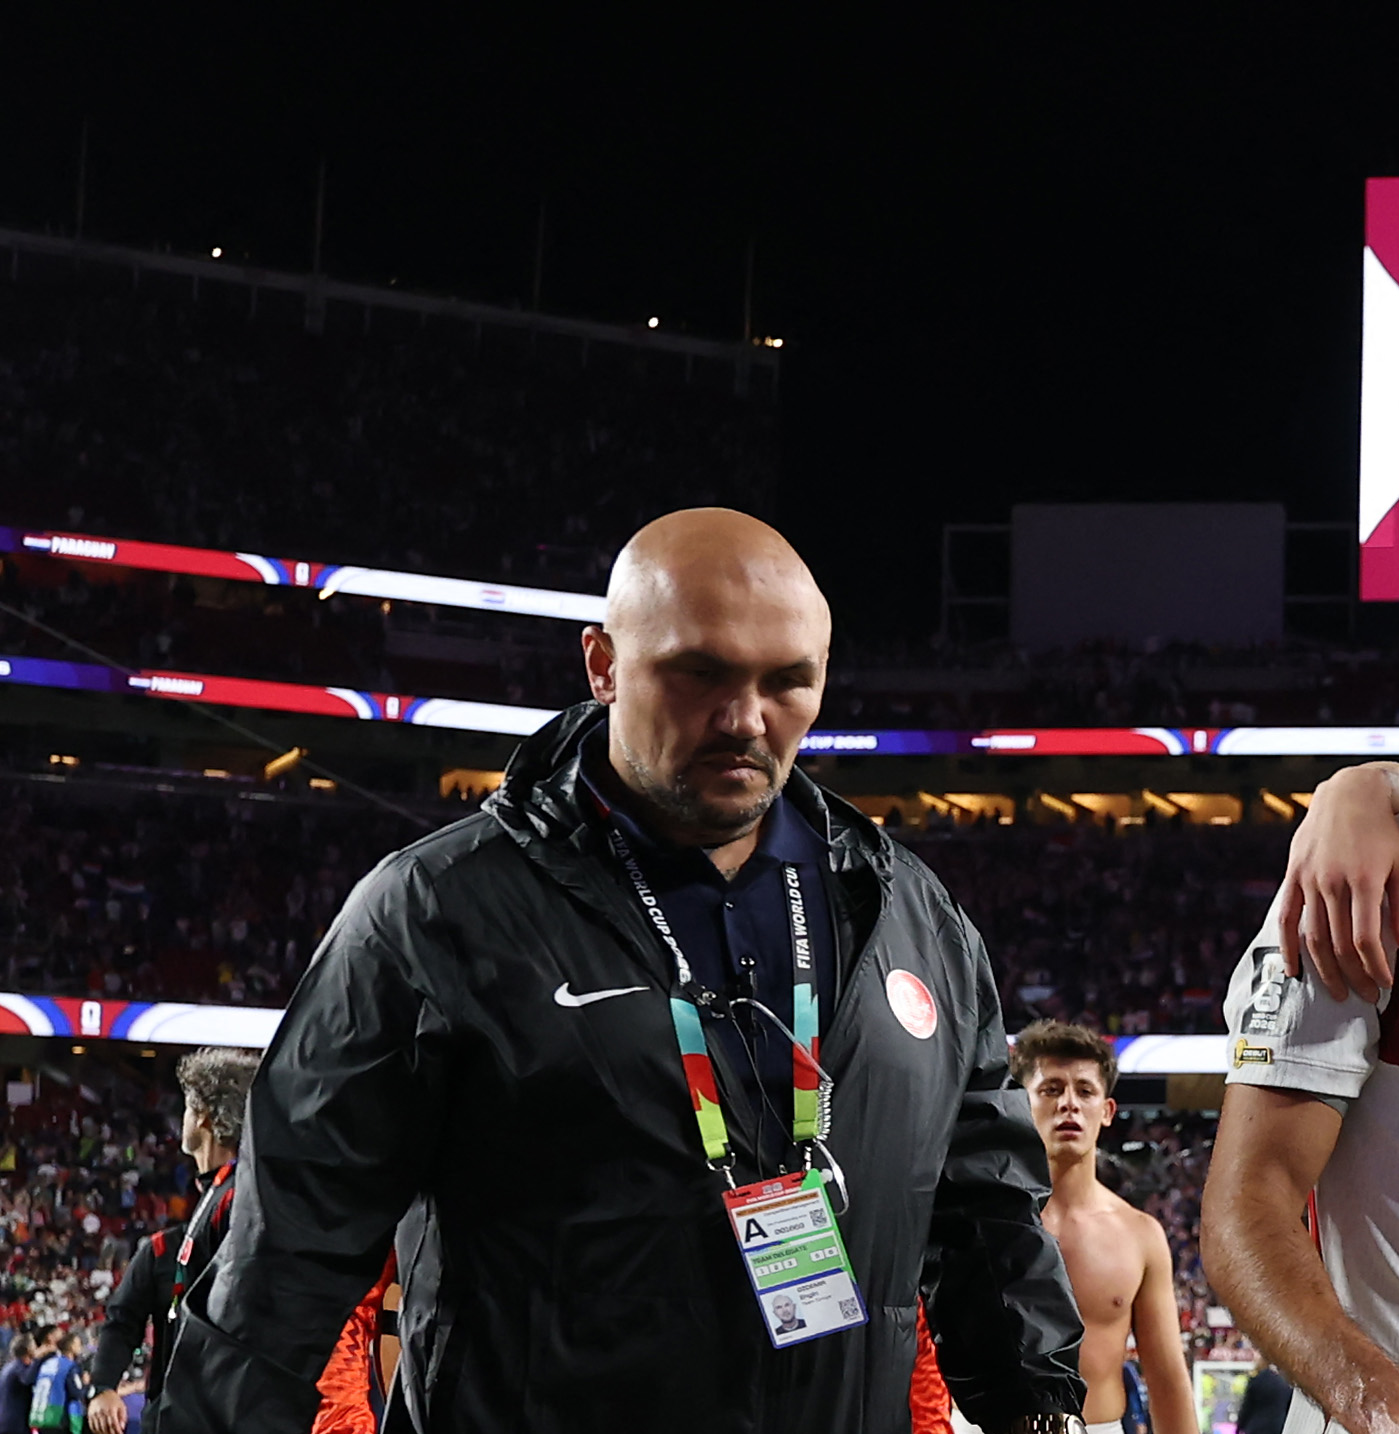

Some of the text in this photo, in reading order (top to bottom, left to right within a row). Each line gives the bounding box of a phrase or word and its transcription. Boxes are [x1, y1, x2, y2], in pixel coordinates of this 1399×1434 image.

[624, 856, 656, 907] WORLD
[648, 905, 672, 936] CUP
[788, 889, 809, 937] WORLD
[796, 938, 811, 970] FIFA
[744, 1217, 769, 1243] A
